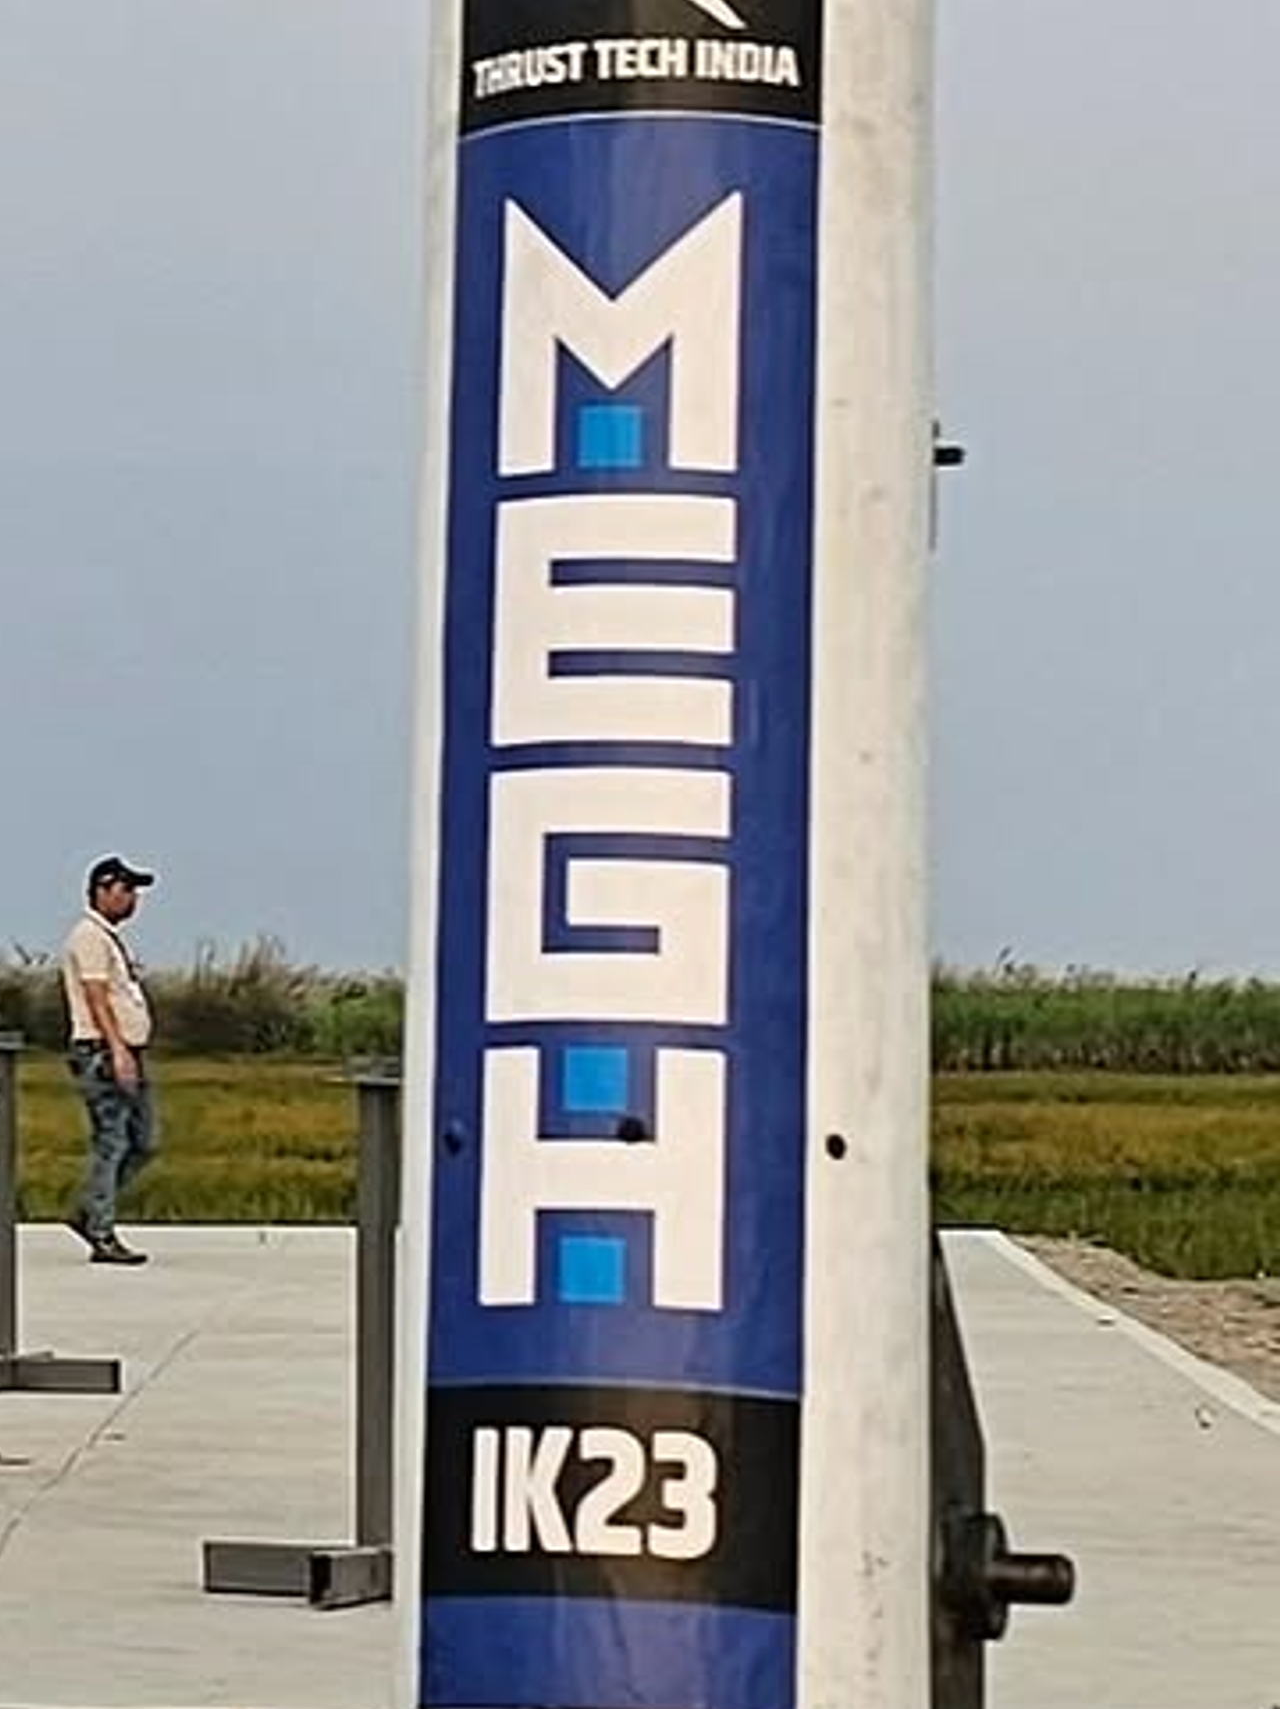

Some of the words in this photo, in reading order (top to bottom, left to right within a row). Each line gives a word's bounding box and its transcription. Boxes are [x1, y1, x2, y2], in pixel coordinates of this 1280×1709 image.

[473, 43, 588, 99] THRUST
[594, 38, 689, 81] TECH
[695, 39, 801, 87] INDIA
[478, 187, 747, 1315] MEGH
[470, 1424, 719, 1561] IK23
